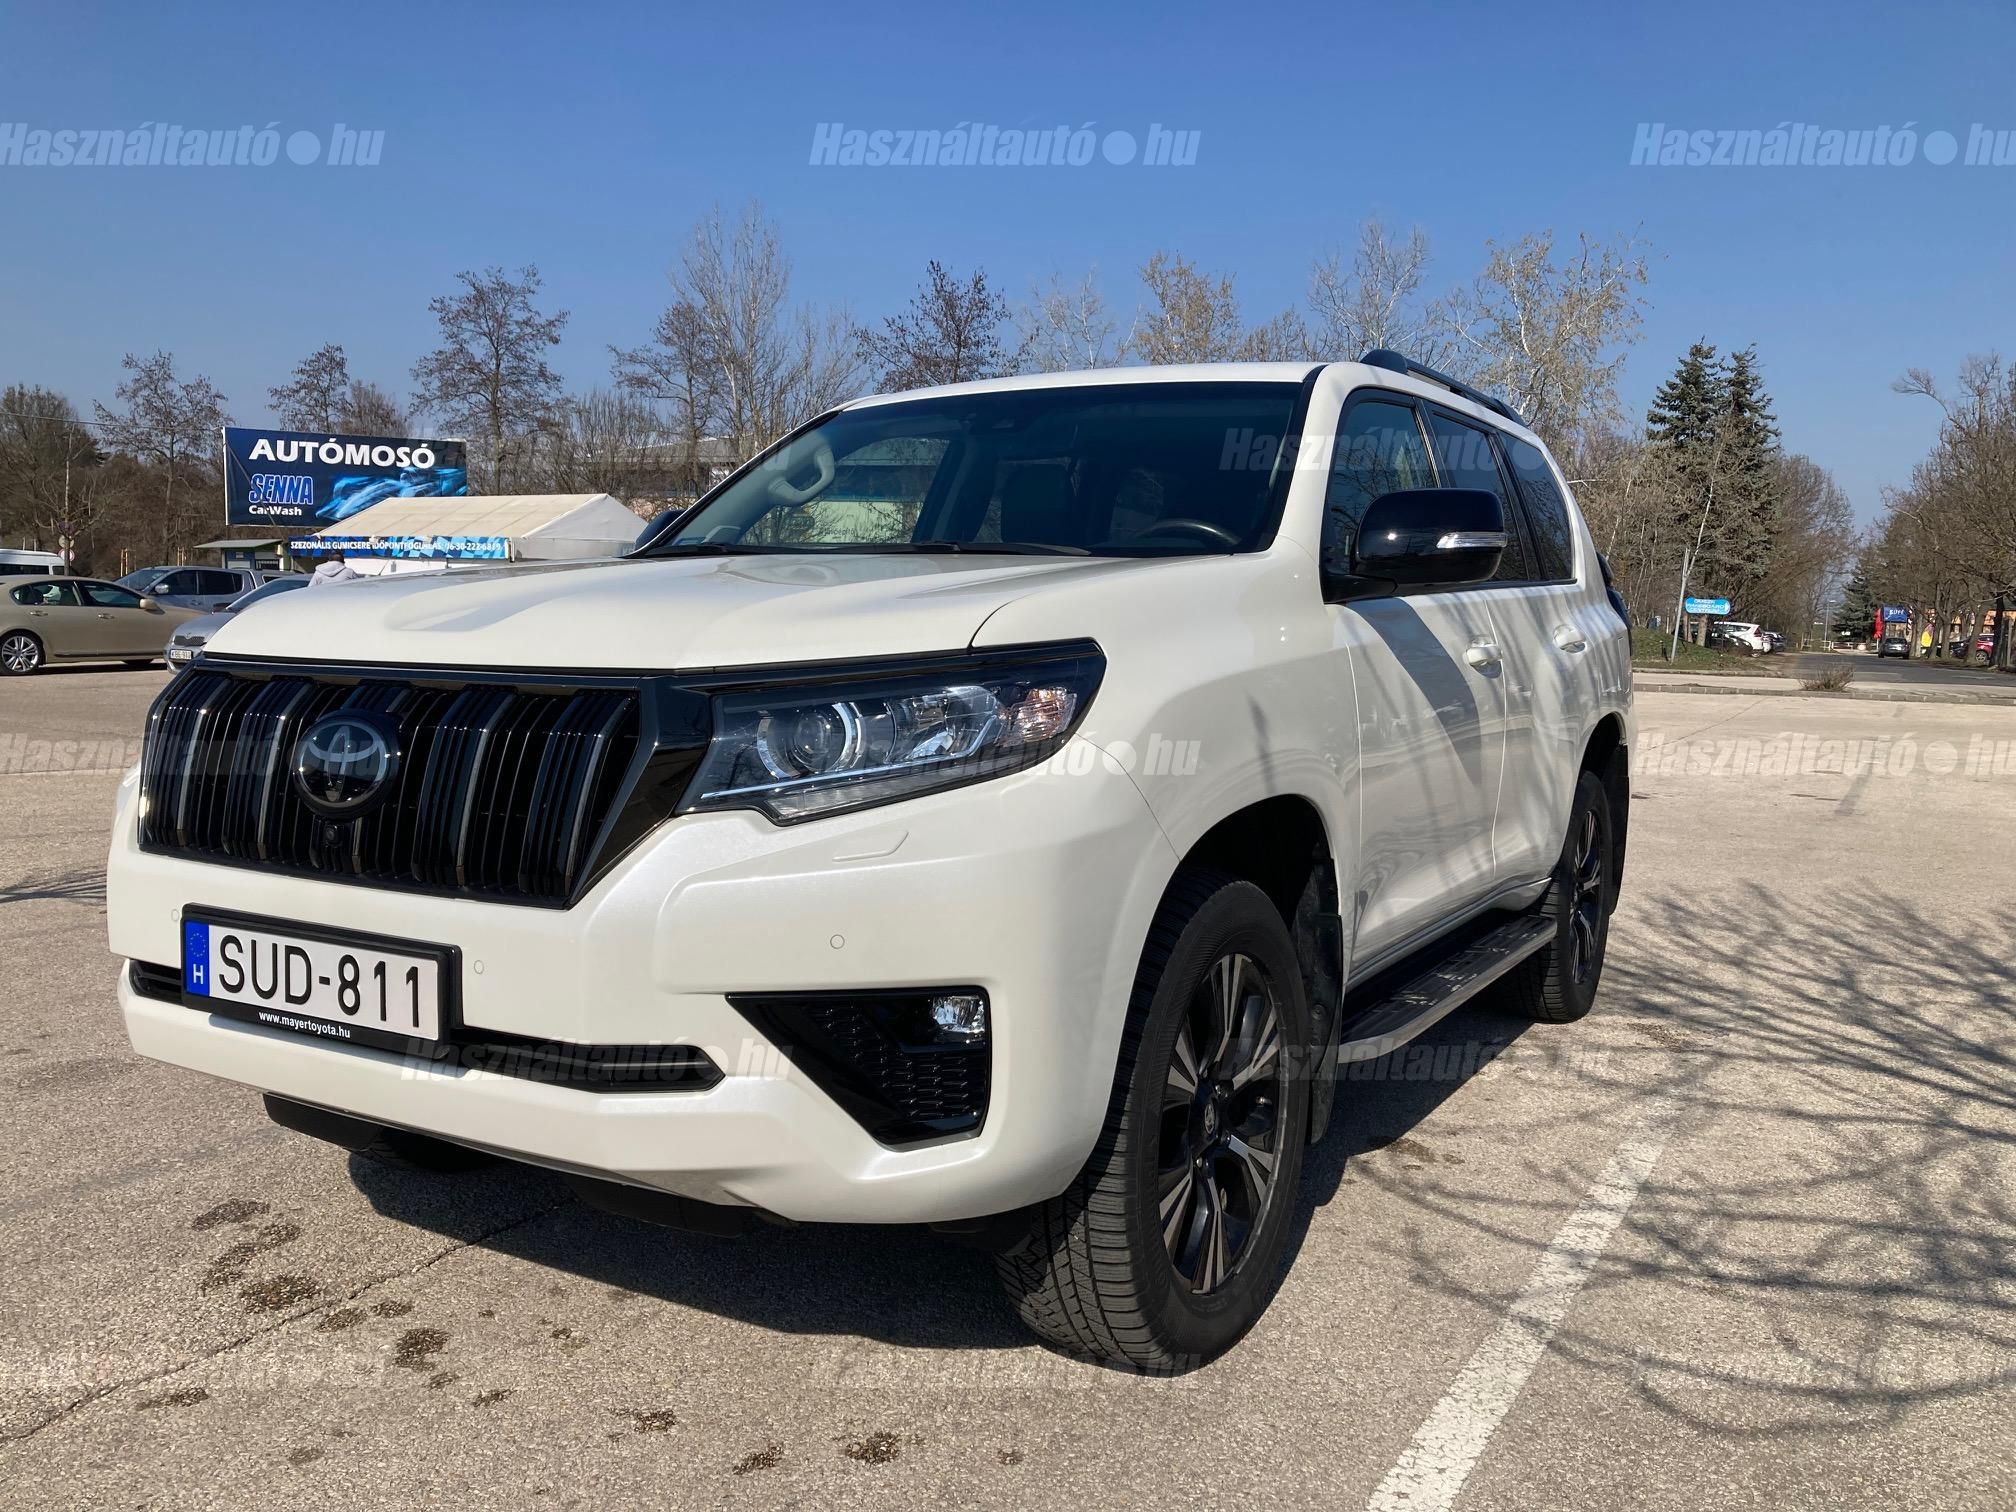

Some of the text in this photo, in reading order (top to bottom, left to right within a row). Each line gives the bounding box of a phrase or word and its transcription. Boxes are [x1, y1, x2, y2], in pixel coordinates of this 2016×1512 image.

[249, 437, 435, 469] AUTÓMOSÓ
[249, 473, 314, 505] SENNA
[193, 964, 204, 984] H
[218, 934, 420, 1029] SUD-811
[259, 1011, 351, 1039] www.mayertoyota.hu
